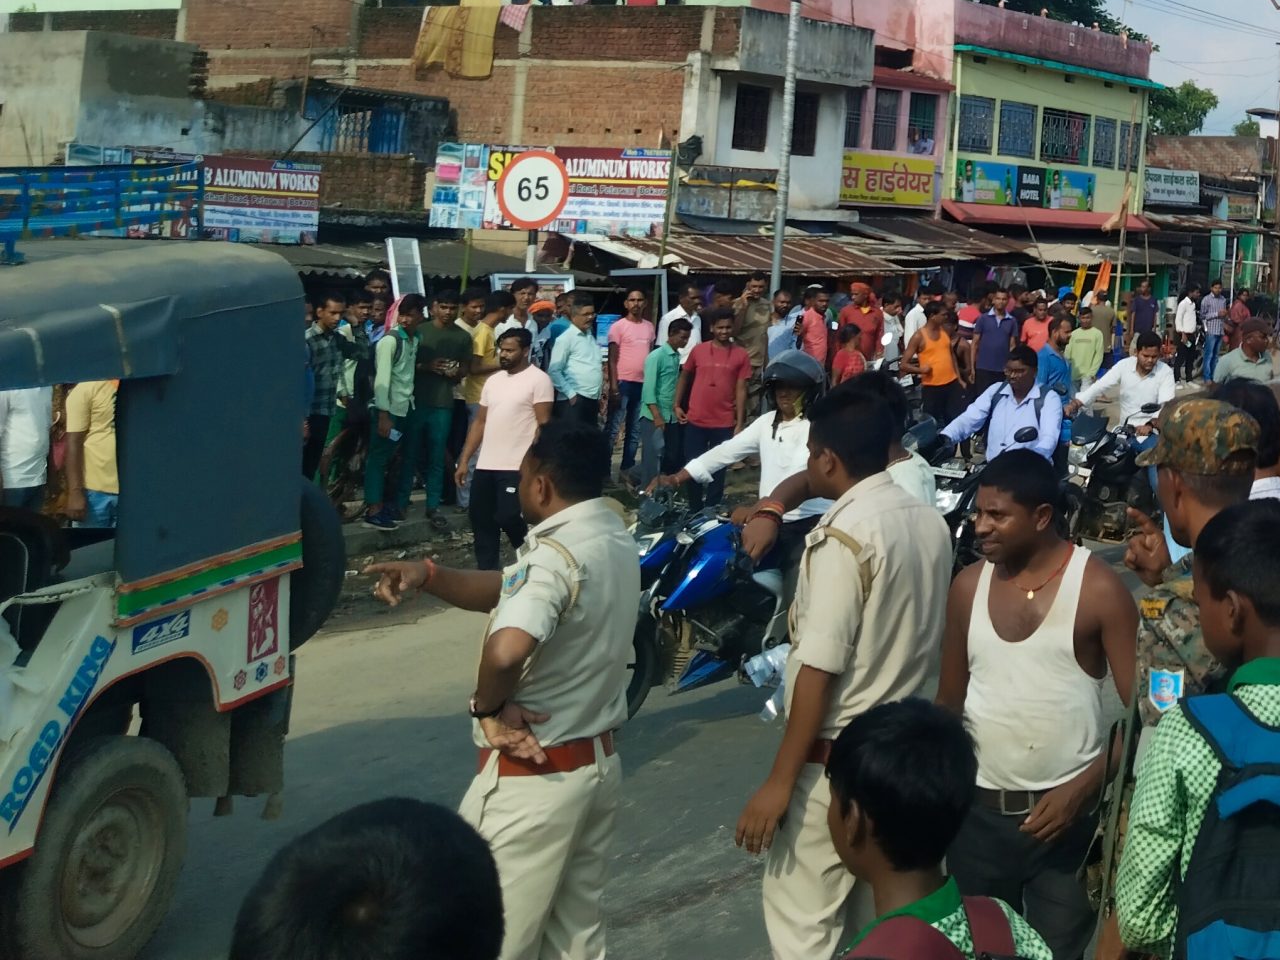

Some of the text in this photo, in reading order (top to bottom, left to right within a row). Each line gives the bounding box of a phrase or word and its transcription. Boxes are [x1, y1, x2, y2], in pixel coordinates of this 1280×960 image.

[565, 158, 628, 178] ALUMINUM
[865, 162, 933, 194] हार्डवेयर
[1022, 173, 1040, 185] BABA
[214, 168, 277, 189] ALUMINUM
[279, 172, 320, 192] WORKS
[517, 176, 549, 202] 65
[636, 185, 669, 198] (Bokaro
[1020, 189, 1040, 201] HOTEL
[0, 634, 112, 823] ROAD KING
